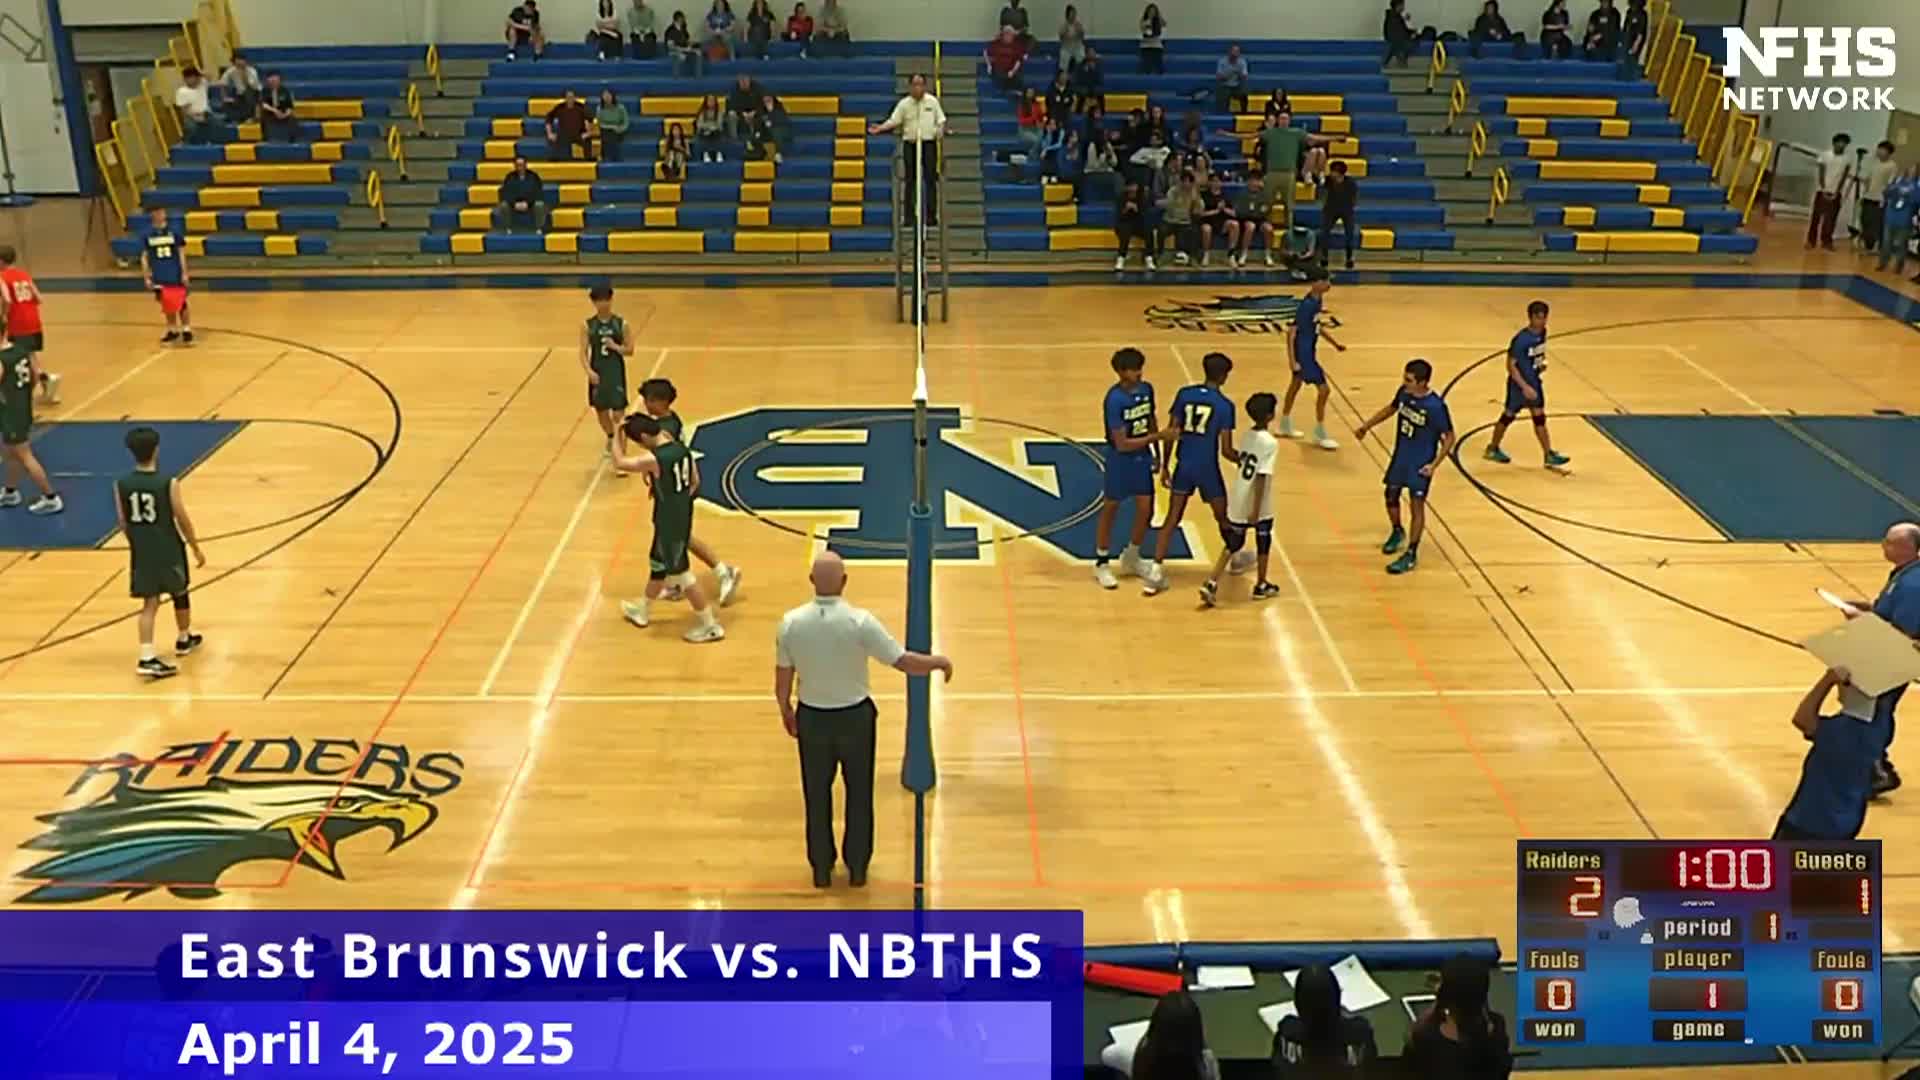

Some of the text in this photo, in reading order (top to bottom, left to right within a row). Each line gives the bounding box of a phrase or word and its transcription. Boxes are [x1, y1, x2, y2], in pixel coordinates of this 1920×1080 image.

[1184, 403, 1212, 434] 17
[129, 492, 157, 523] 13
[64, 735, 465, 801] RAIDERS
